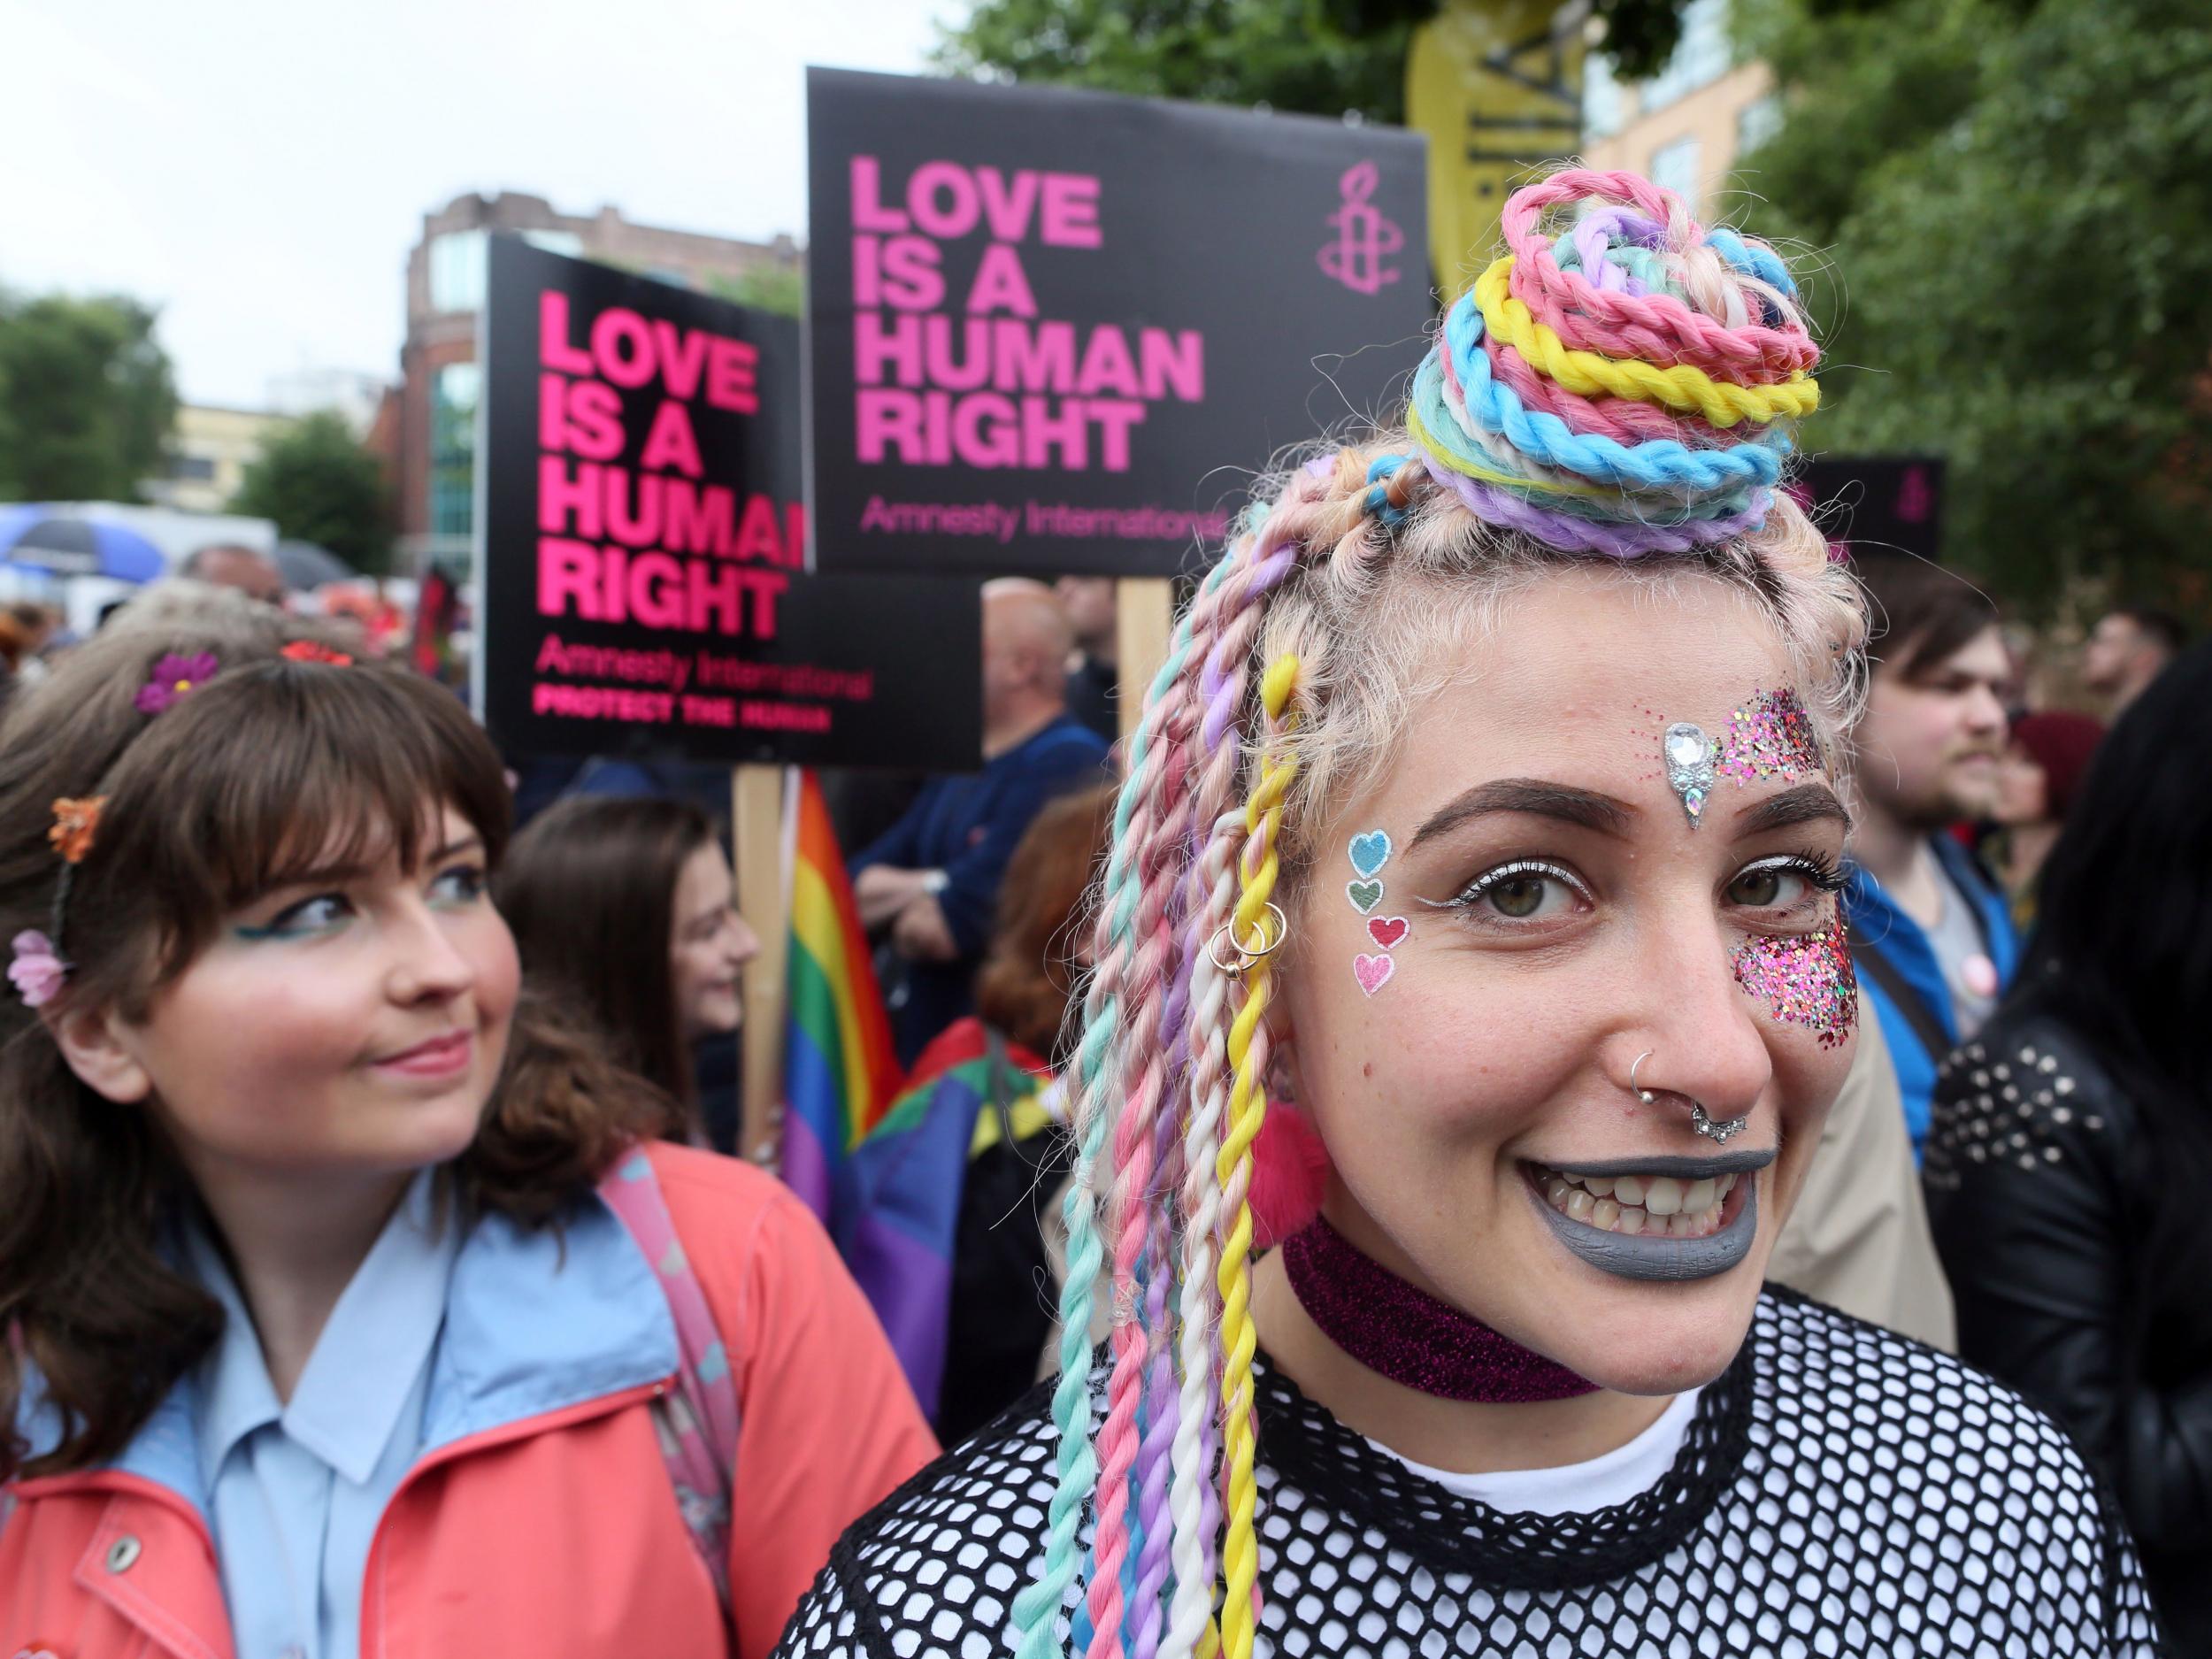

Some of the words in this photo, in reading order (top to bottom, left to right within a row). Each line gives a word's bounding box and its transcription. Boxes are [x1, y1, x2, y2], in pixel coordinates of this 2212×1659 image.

[853, 157, 1101, 247] LOVE
[856, 235, 944, 309] IS
[968, 244, 1036, 315] A
[541, 291, 757, 412] LOVE
[856, 311, 1202, 400] HUMAN
[541, 373, 624, 460] IS
[641, 402, 702, 477] A
[858, 390, 1144, 470] RIGHT
[862, 497, 1019, 542] Amnesty
[539, 537, 787, 637] RIGHT
[534, 685, 672, 721] PROTECT
[682, 696, 734, 726] THE
[742, 703, 830, 732] HUMAN
[537, 634, 690, 692] Amnesty
[699, 653, 872, 699] International
